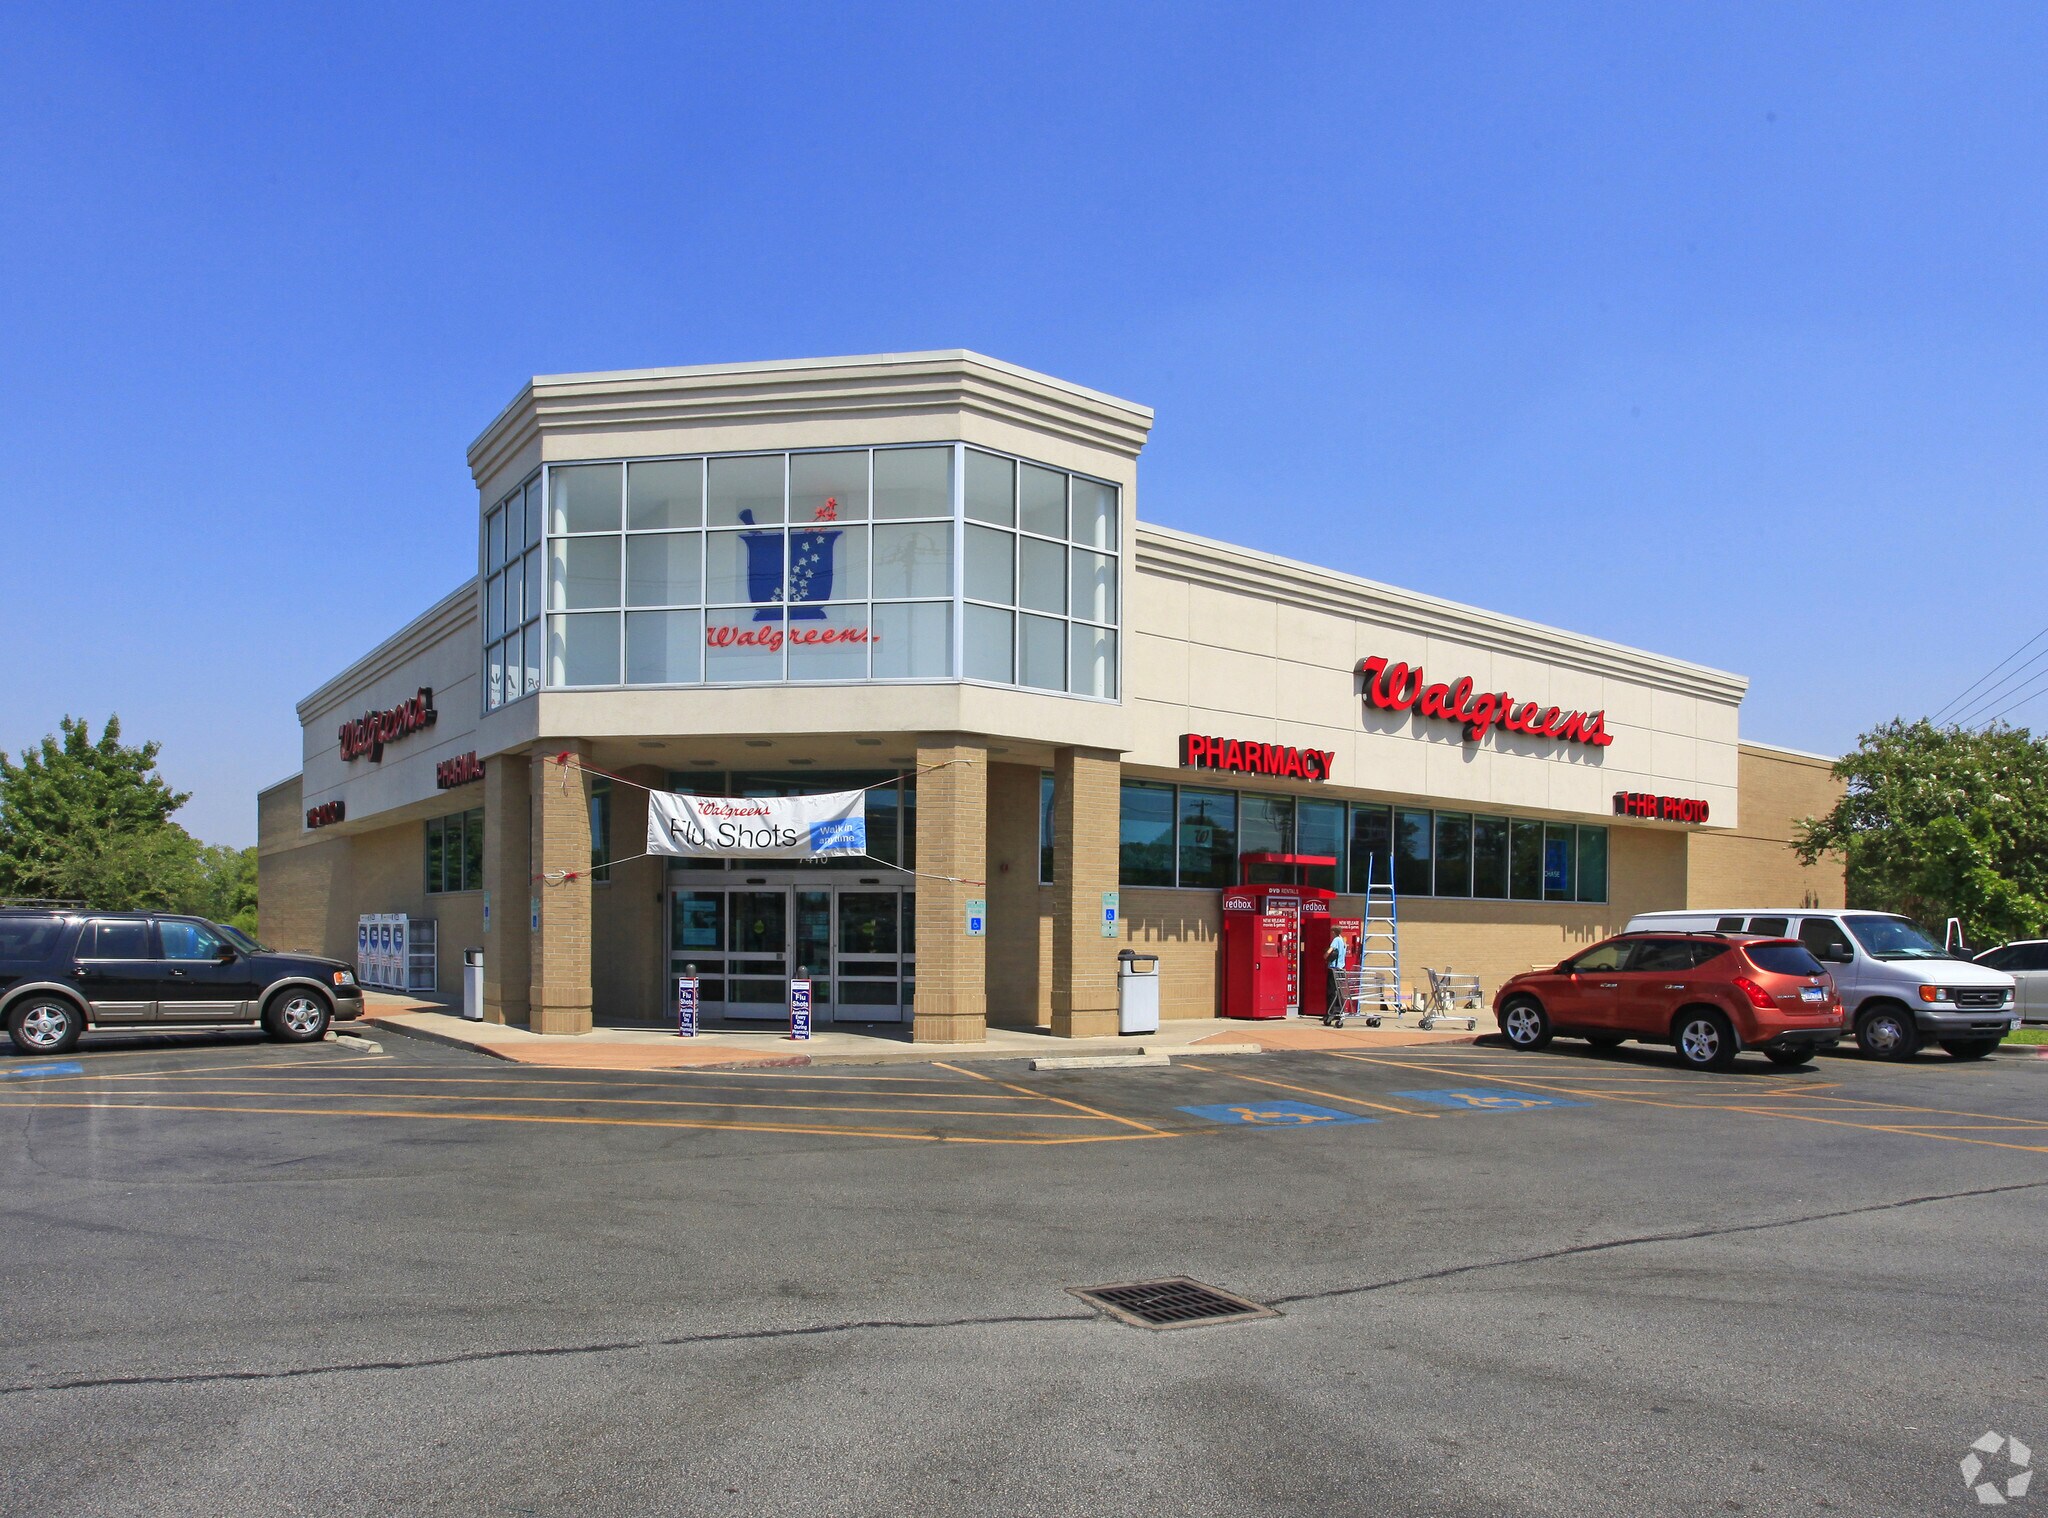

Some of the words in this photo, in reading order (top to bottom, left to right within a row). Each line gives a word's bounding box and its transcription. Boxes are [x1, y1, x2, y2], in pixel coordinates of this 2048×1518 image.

[707, 625, 881, 652] Walgreens
[1360, 656, 1614, 747] Walgreens
[1184, 733, 1336, 780] PHARMACY
[698, 802, 771, 820] Walgreens
[1664, 796, 1710, 822] PHOTO
[670, 818, 706, 846] Flu
[717, 822, 798, 848] Shots
[820, 824, 844, 834] Walk
[820, 835, 855, 845] anytime
[1225, 899, 1252, 909] redbox
[1302, 901, 1327, 911] redbox
